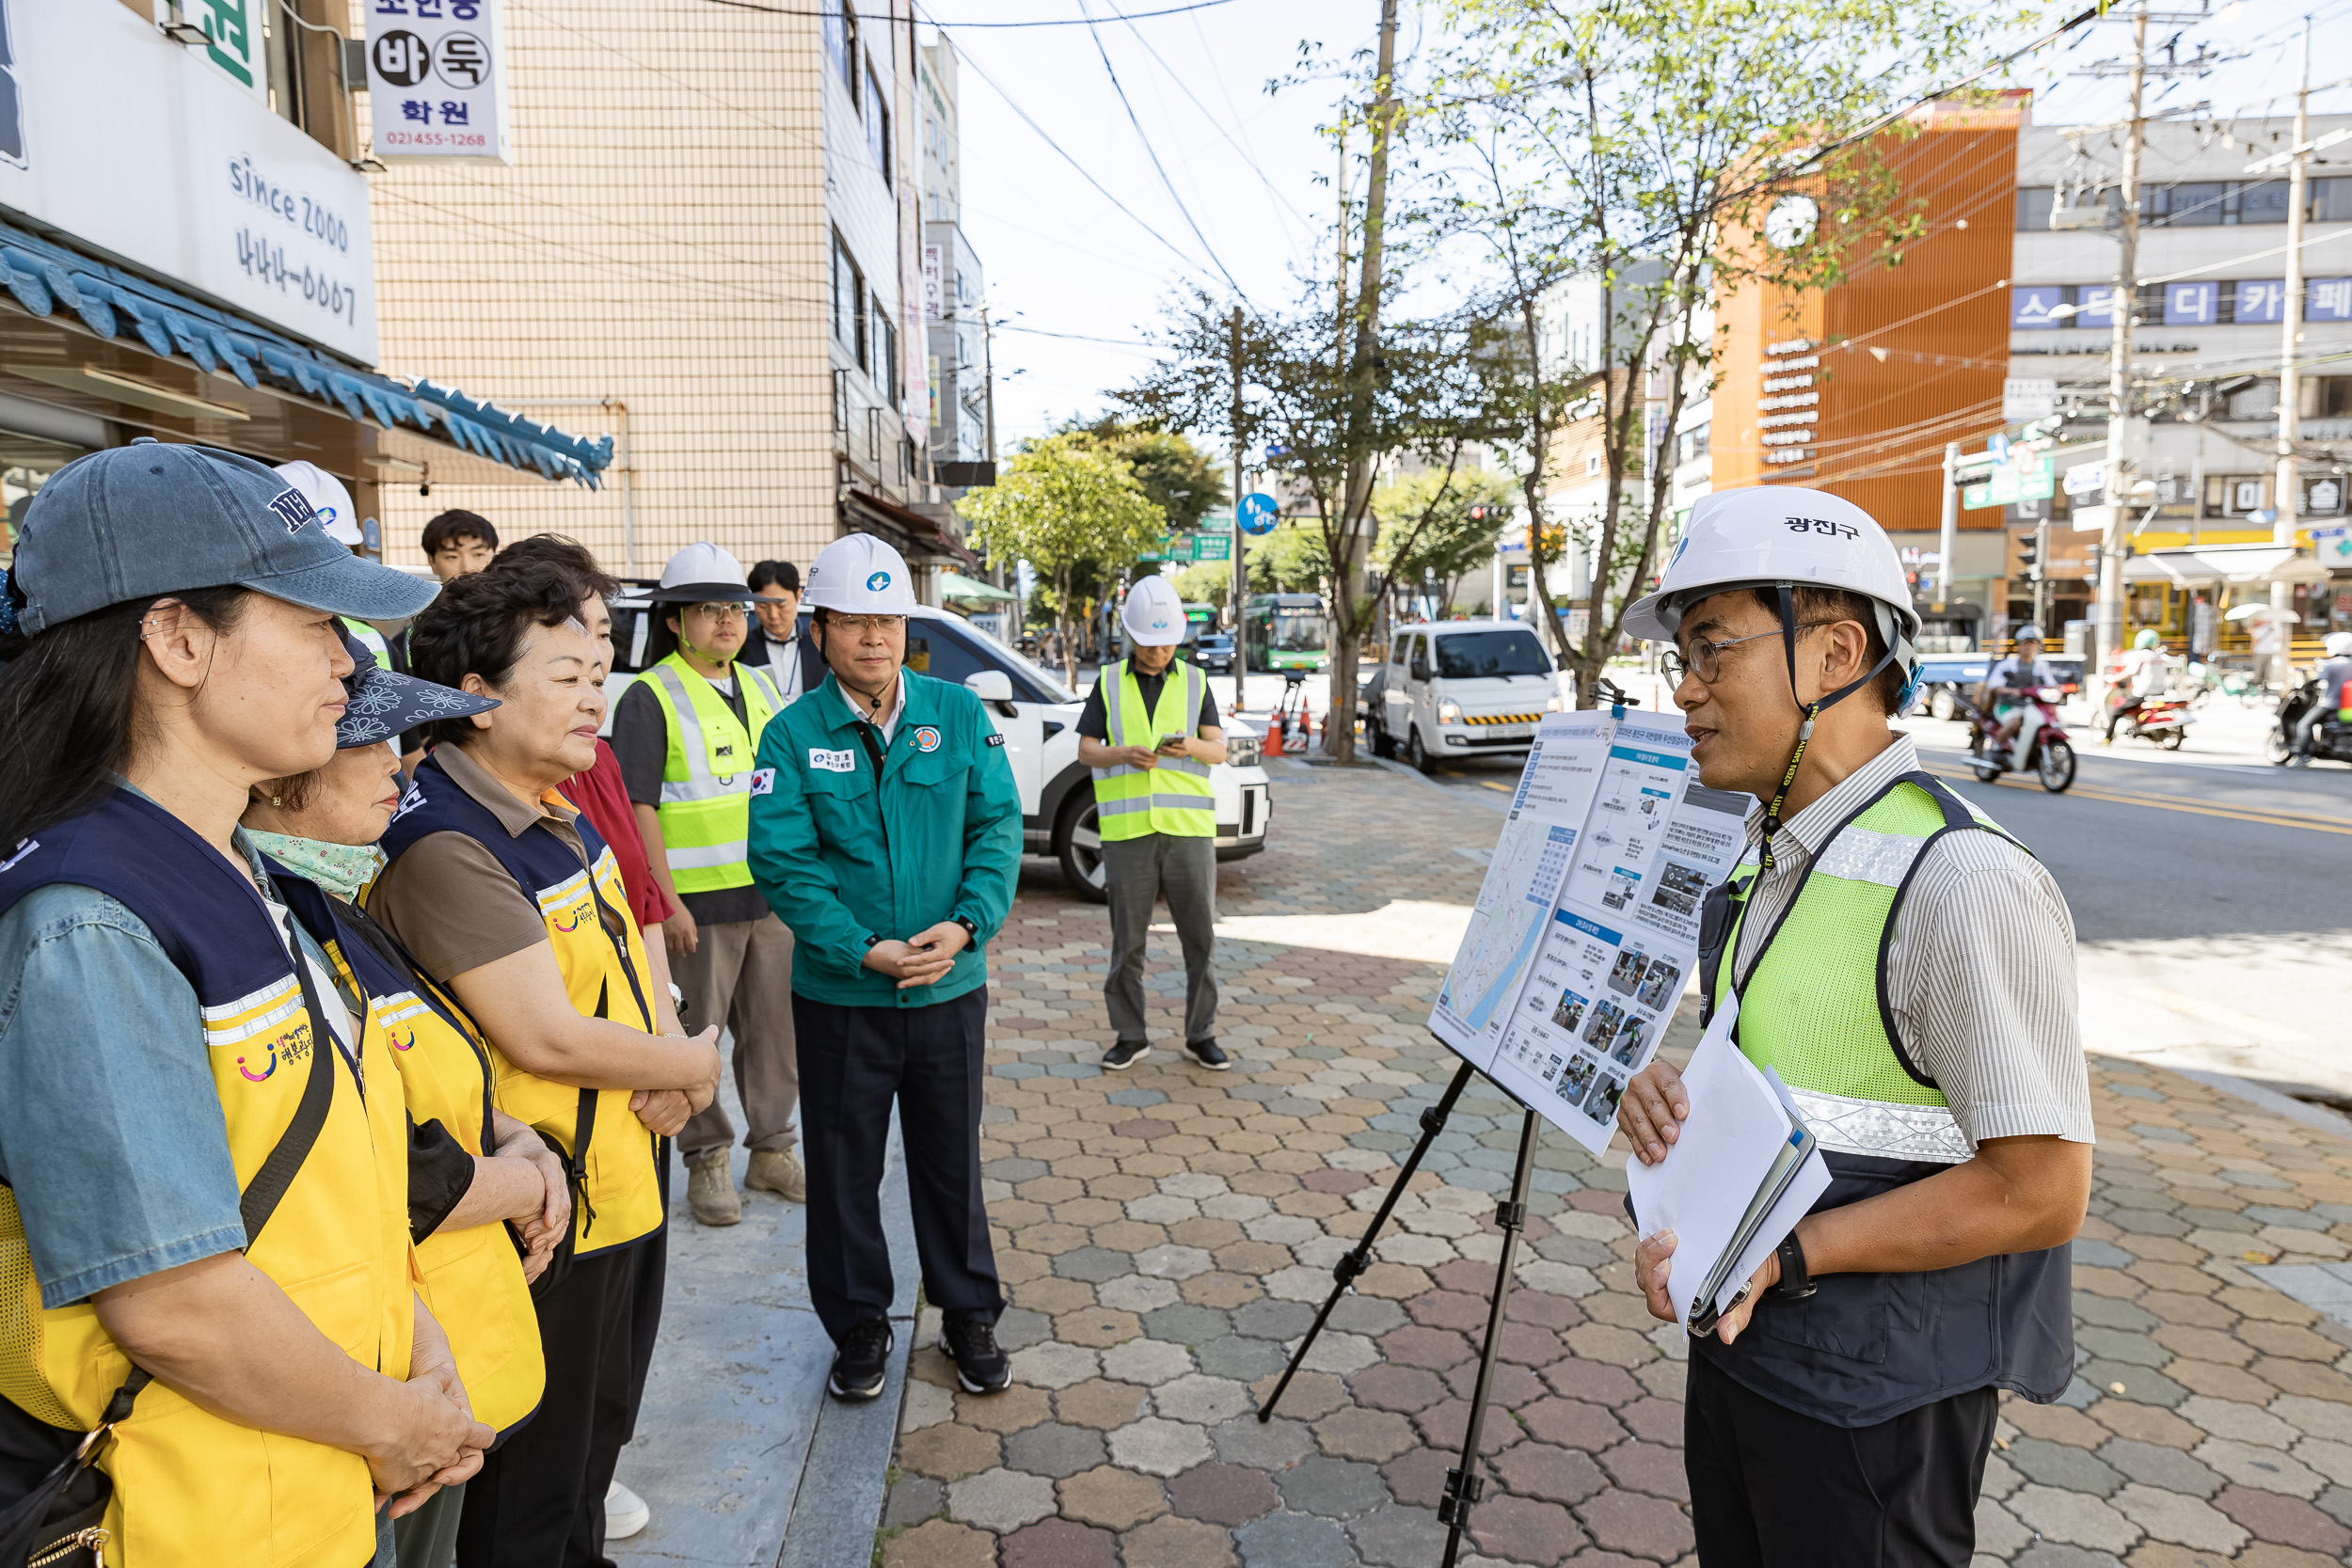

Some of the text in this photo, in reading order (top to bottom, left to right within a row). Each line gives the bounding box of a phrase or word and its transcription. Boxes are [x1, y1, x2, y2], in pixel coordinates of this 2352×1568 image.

[378, 34, 484, 86] 바둑
[402, 100, 469, 125] 학원
[386, 131, 486, 147] 02)455-1268
[230, 157, 348, 253] since 2000
[237, 228, 355, 326] 444-0007
[1783, 516, 1861, 541] 광진구
[1791, 740, 1807, 763] SAFETY
[1769, 795, 1784, 816] SAFETY
